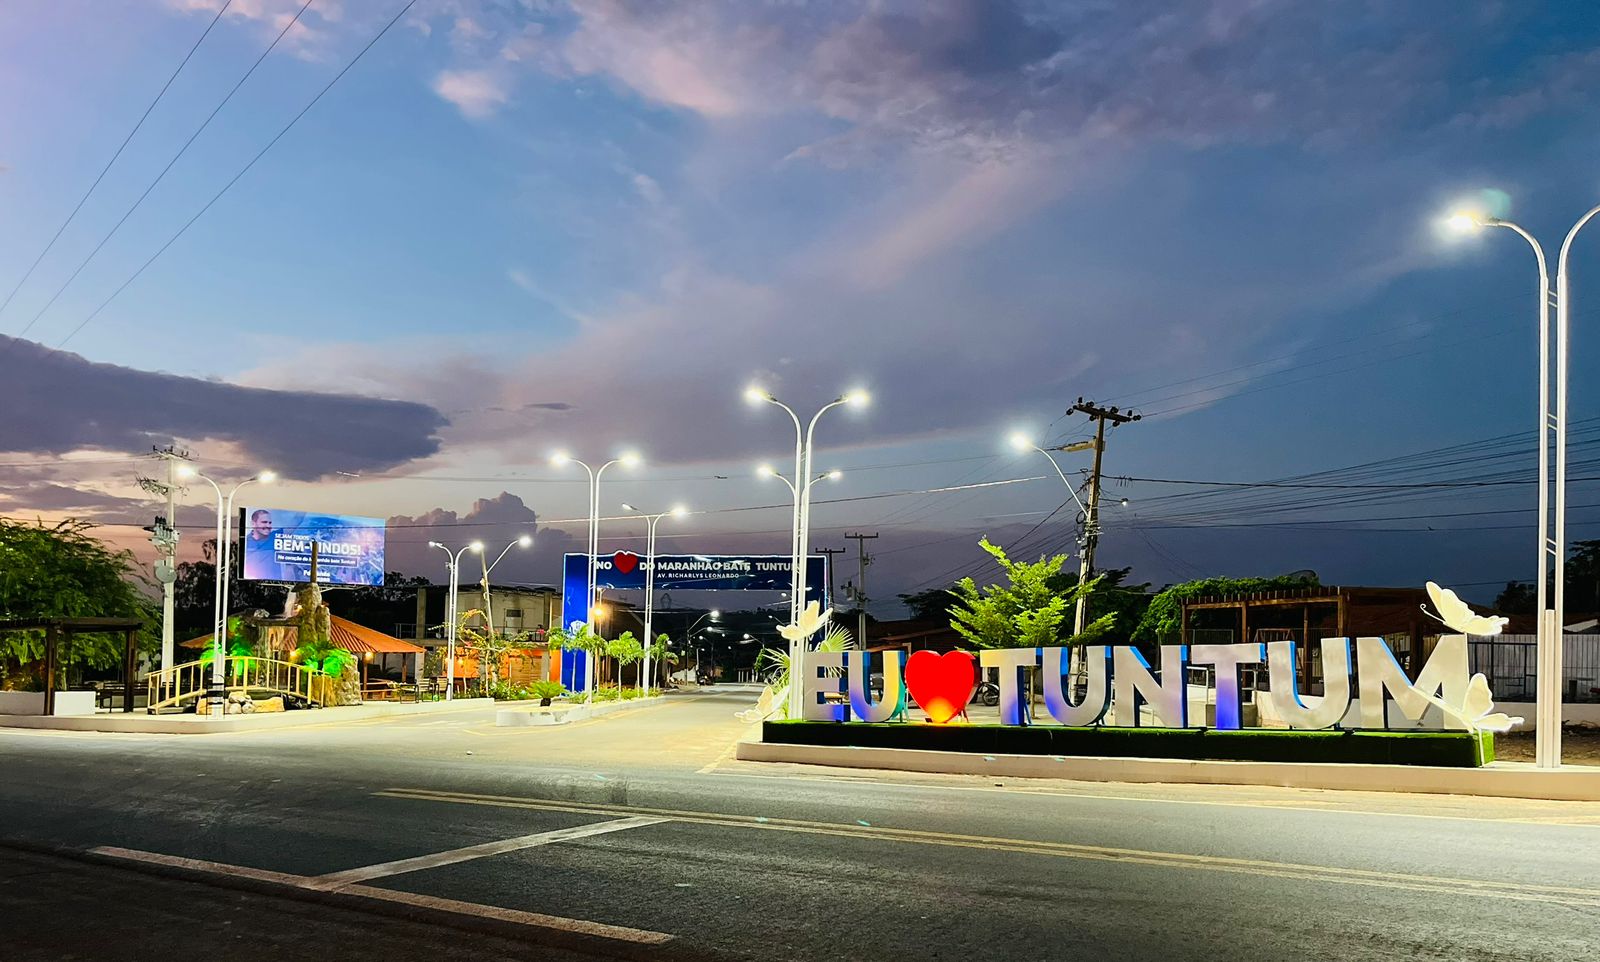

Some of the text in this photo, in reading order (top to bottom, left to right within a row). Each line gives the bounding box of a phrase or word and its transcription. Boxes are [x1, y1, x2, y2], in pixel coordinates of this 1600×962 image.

[596, 560, 612, 570] NO
[756, 562, 796, 571] TUNTU
[802, 634, 1471, 731] EU TUNTUM
